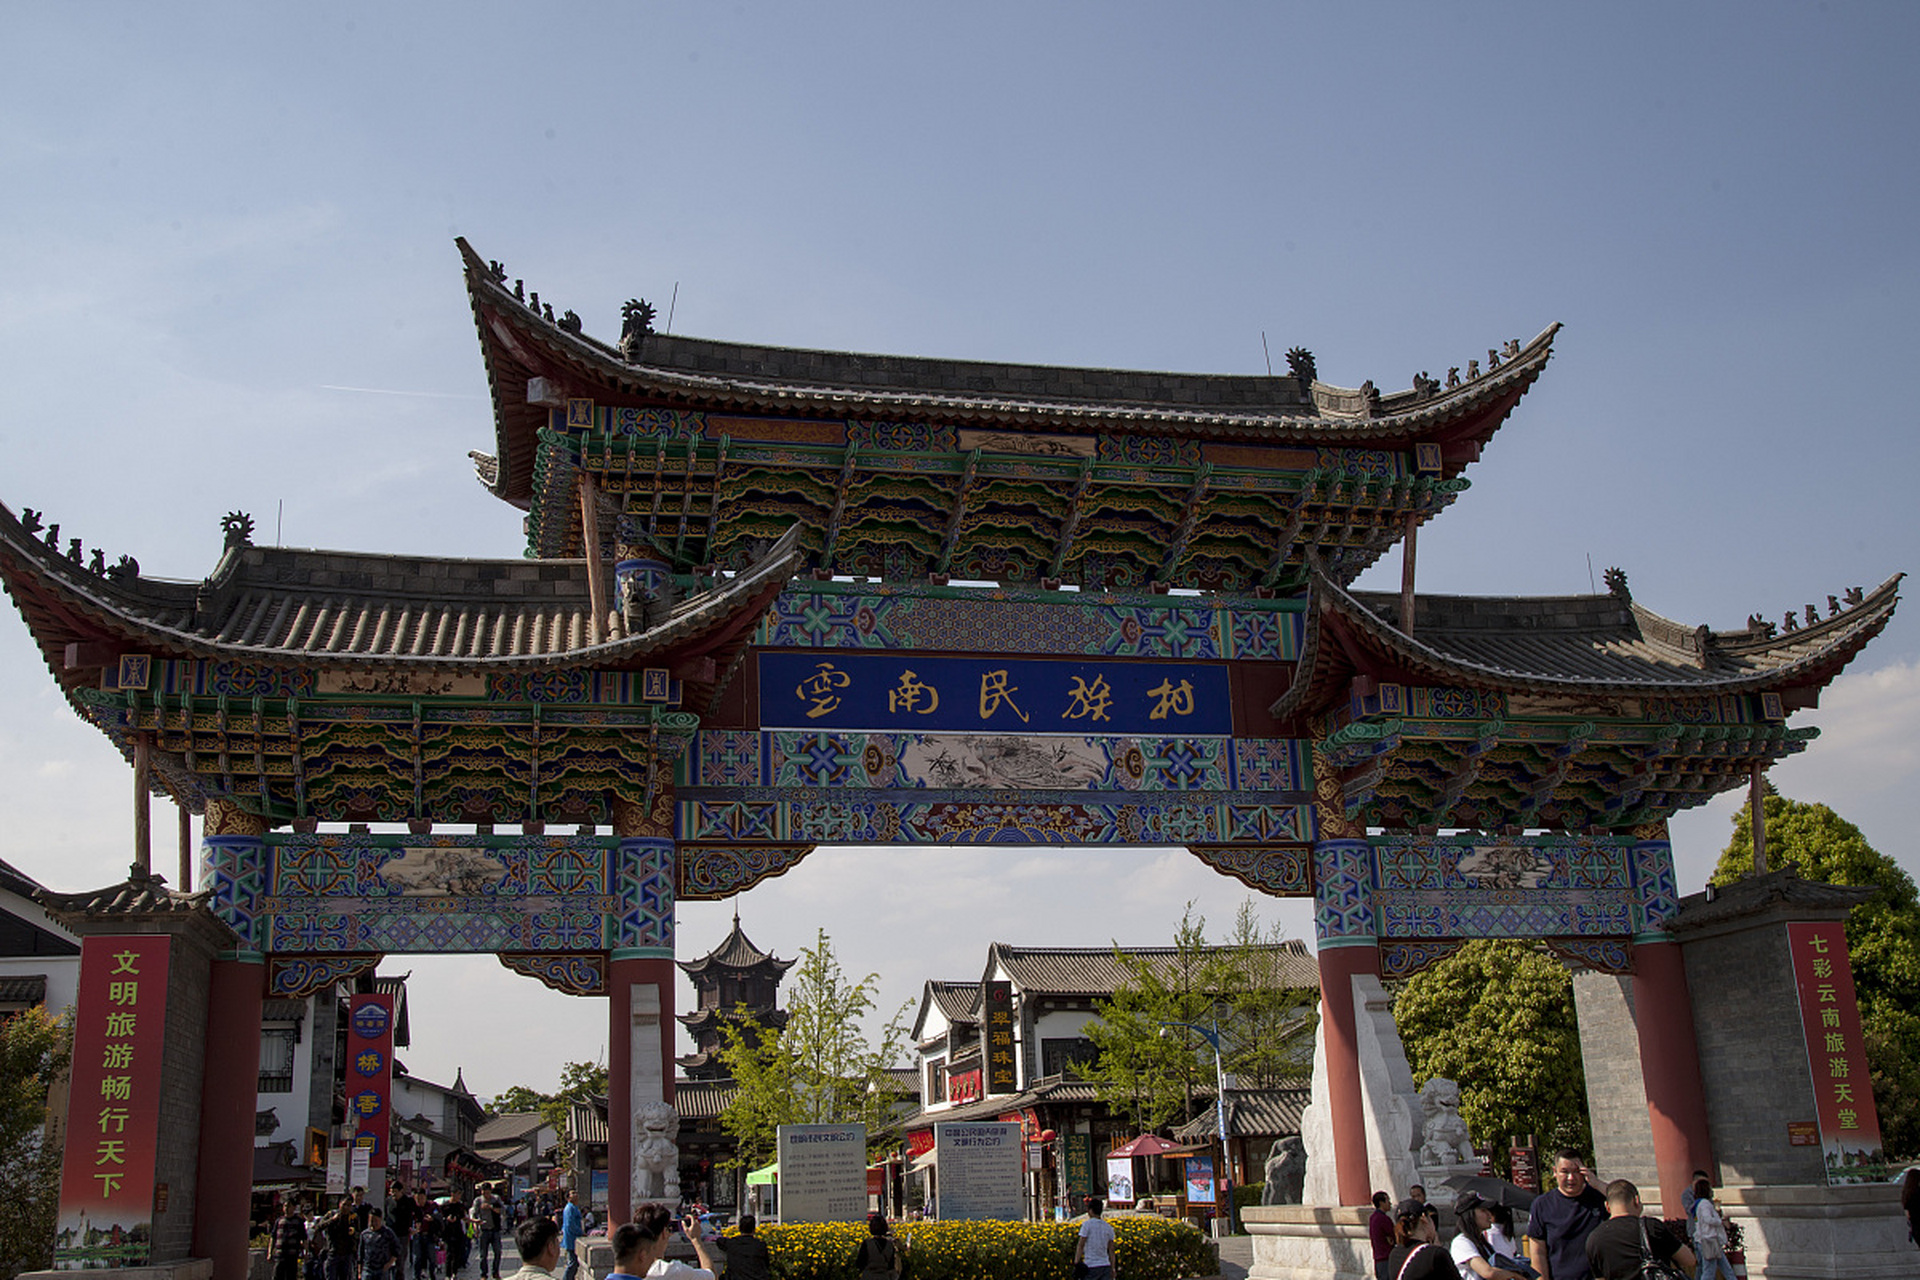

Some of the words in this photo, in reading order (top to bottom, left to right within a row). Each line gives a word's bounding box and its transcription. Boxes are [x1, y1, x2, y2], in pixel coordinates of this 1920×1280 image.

[93, 949, 141, 1199] 文明旅游畅行天下
[991, 1011, 1014, 1084] 翠福珠宝
[1808, 934, 1859, 1131] 七彩云南旅游天堂
[1068, 1135, 1088, 1193] 翠福珠宝
